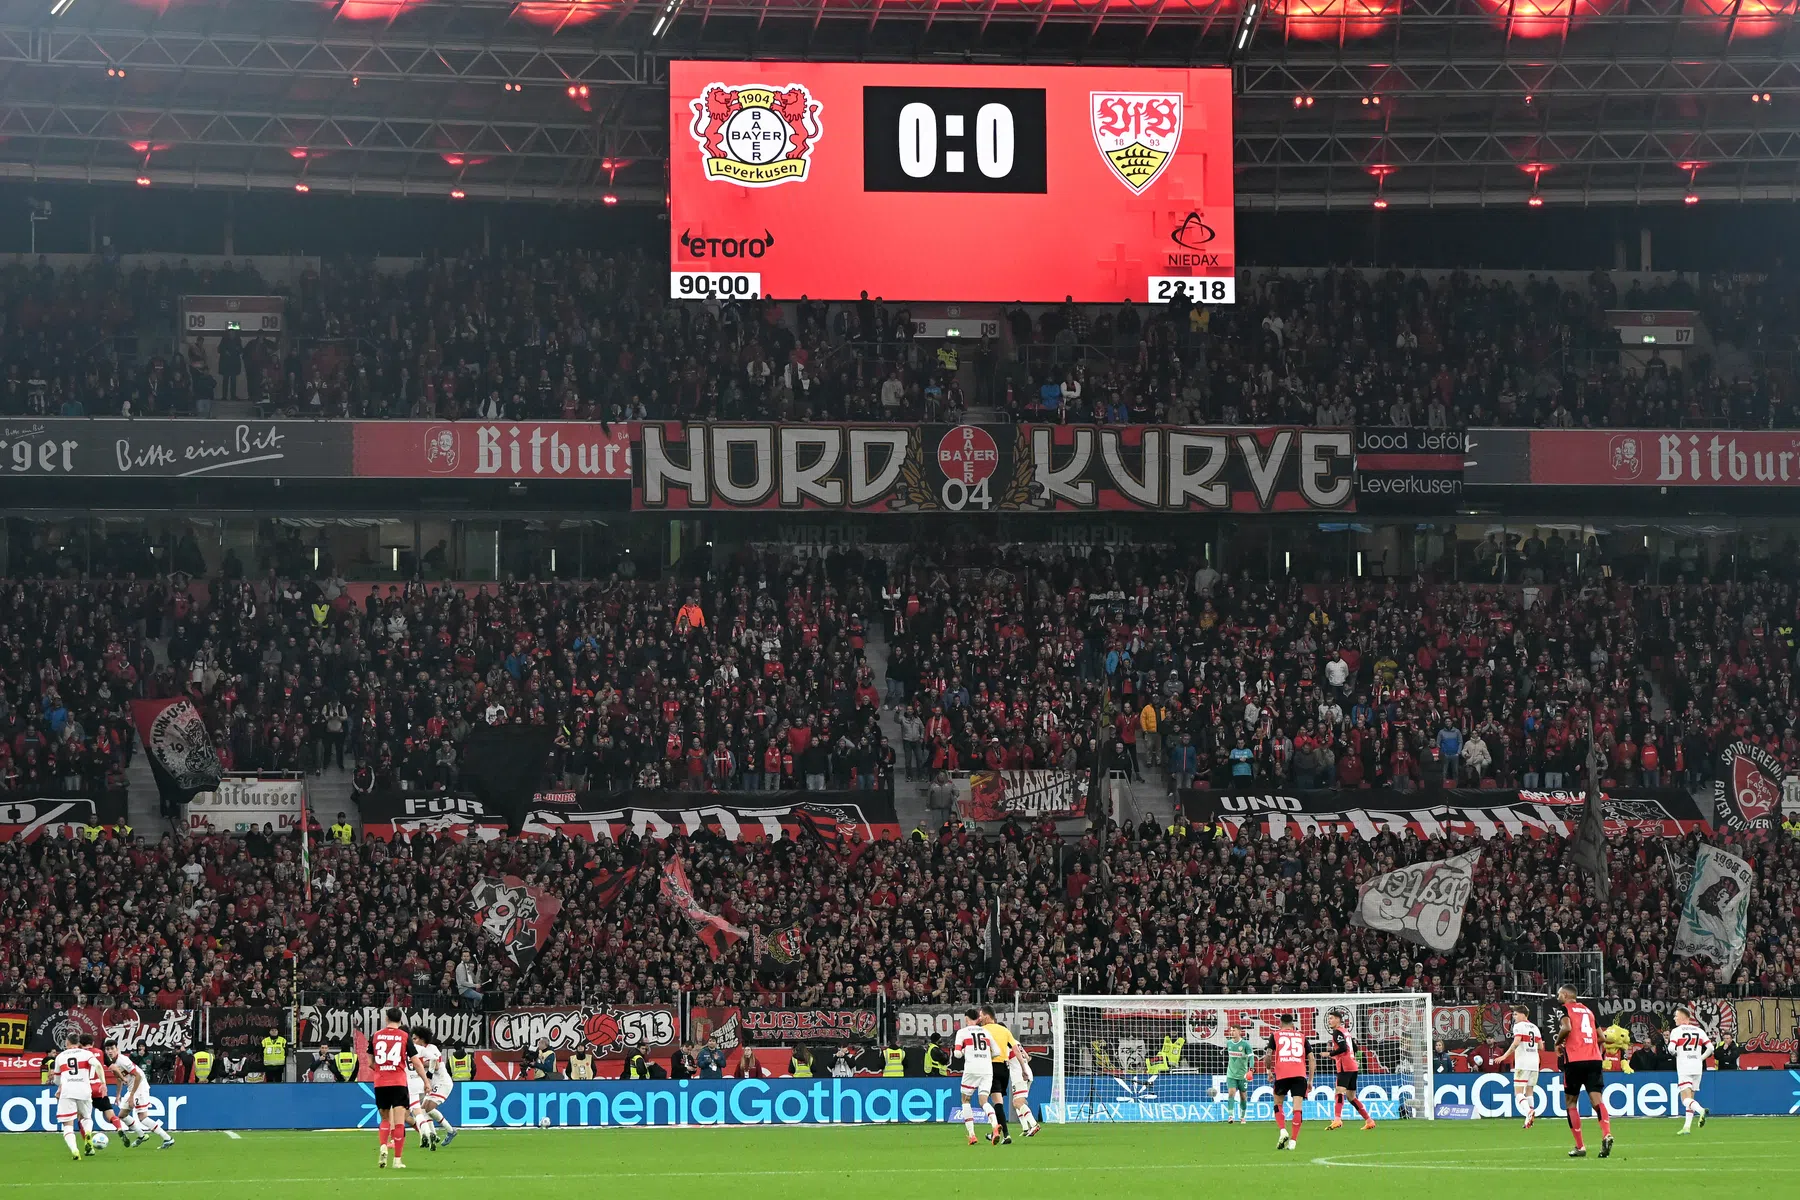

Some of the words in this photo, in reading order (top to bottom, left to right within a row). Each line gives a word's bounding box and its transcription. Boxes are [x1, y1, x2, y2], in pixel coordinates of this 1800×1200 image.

[741, 93, 770, 104] 1904
[732, 131, 782, 140] BAYER
[751, 111, 762, 161] BAYER
[898, 102, 1015, 178] 0:0
[715, 161, 798, 179] Leverkusen
[1168, 254, 1219, 266] NIEDAX
[680, 275, 749, 294] 90:00
[1357, 431, 1408, 451] Jood
[0, 440, 79, 472] ger
[116, 438, 177, 471] Bitte
[184, 440, 229, 460] ein
[940, 450, 996, 461] BAYER
[962, 427, 975, 484] BAYER
[1656, 433, 1800, 481] Bitbur
[642, 427, 909, 503] NORD
[1032, 429, 1351, 506] KURVE
[941, 477, 993, 511] 04
[1359, 475, 1463, 495] Leverkusen
[211, 786, 298, 806] Bitburger
[404, 795, 485, 815] FÜR
[1220, 795, 1303, 812] UND
[190, 814, 209, 829] D4
[1597, 998, 1637, 1016] MAD
[36, 1013, 57, 1036] Bayer
[495, 1012, 583, 1049] CHAOS
[622, 1011, 674, 1046] 513
[1580, 1013, 1593, 1038] 4
[970, 1032, 987, 1051] 16
[1278, 1036, 1303, 1057] 25
[1528, 1030, 1535, 1048] 3
[1682, 1032, 1699, 1051] 27
[375, 1040, 402, 1066] 34
[67, 1057, 78, 1076] 9
[461, 1078, 952, 1126] BarmeniaGothaer
[1045, 1104, 1124, 1120] NEDAX
[1139, 1103, 1215, 1120] NIEDAX
